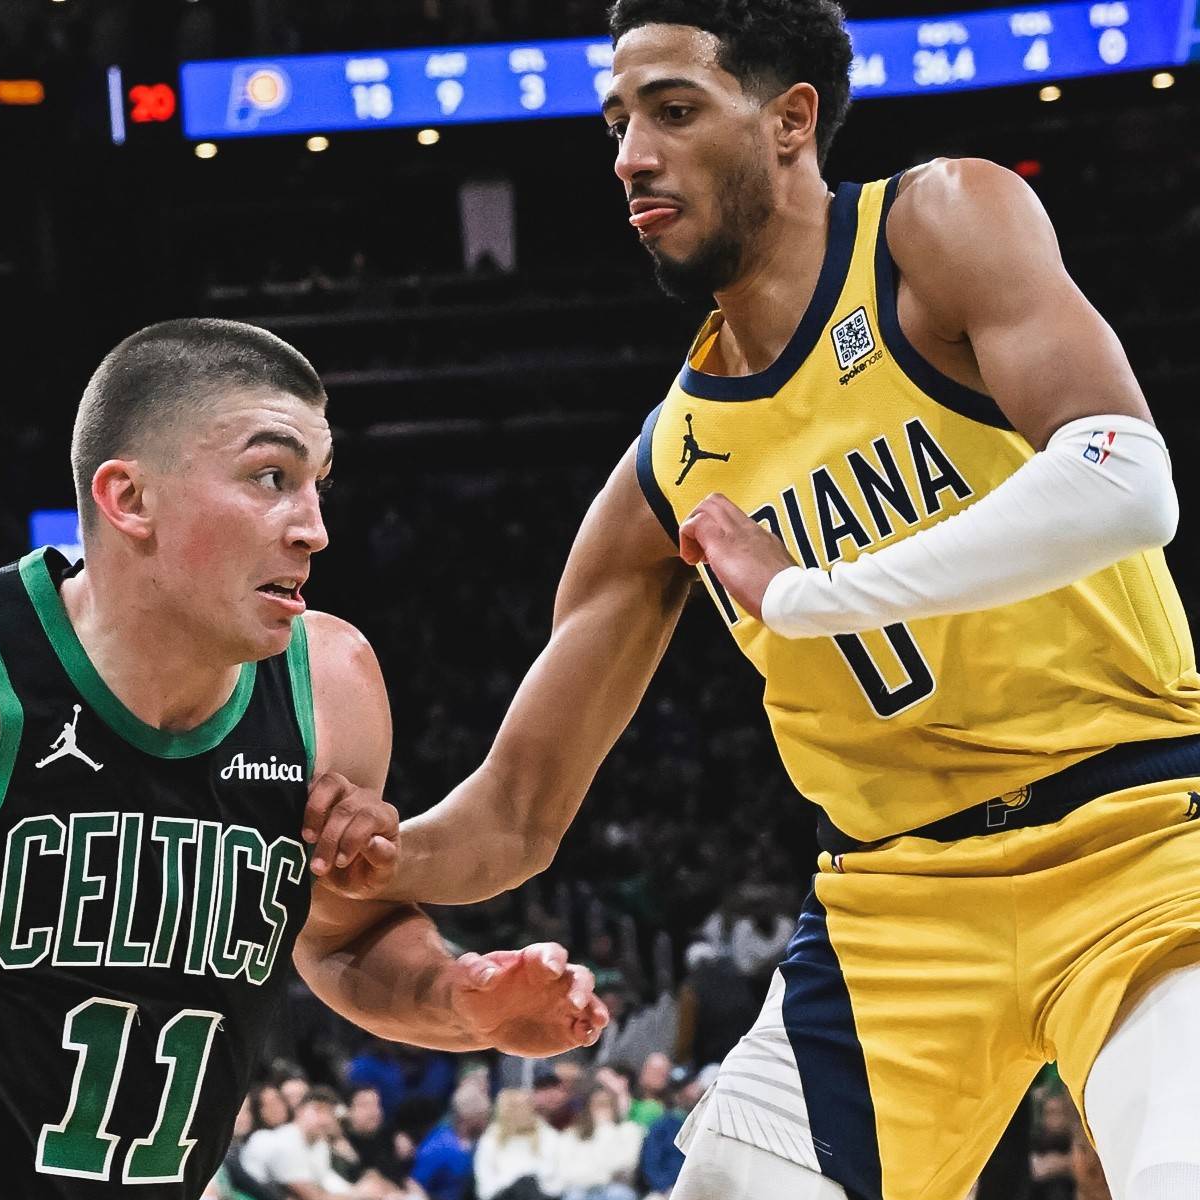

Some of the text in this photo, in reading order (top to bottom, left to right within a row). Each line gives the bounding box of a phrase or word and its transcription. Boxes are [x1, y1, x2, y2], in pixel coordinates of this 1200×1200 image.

[839, 349, 883, 386] spokenote
[221, 752, 304, 783] Amica
[35, 996, 225, 1185] 11
